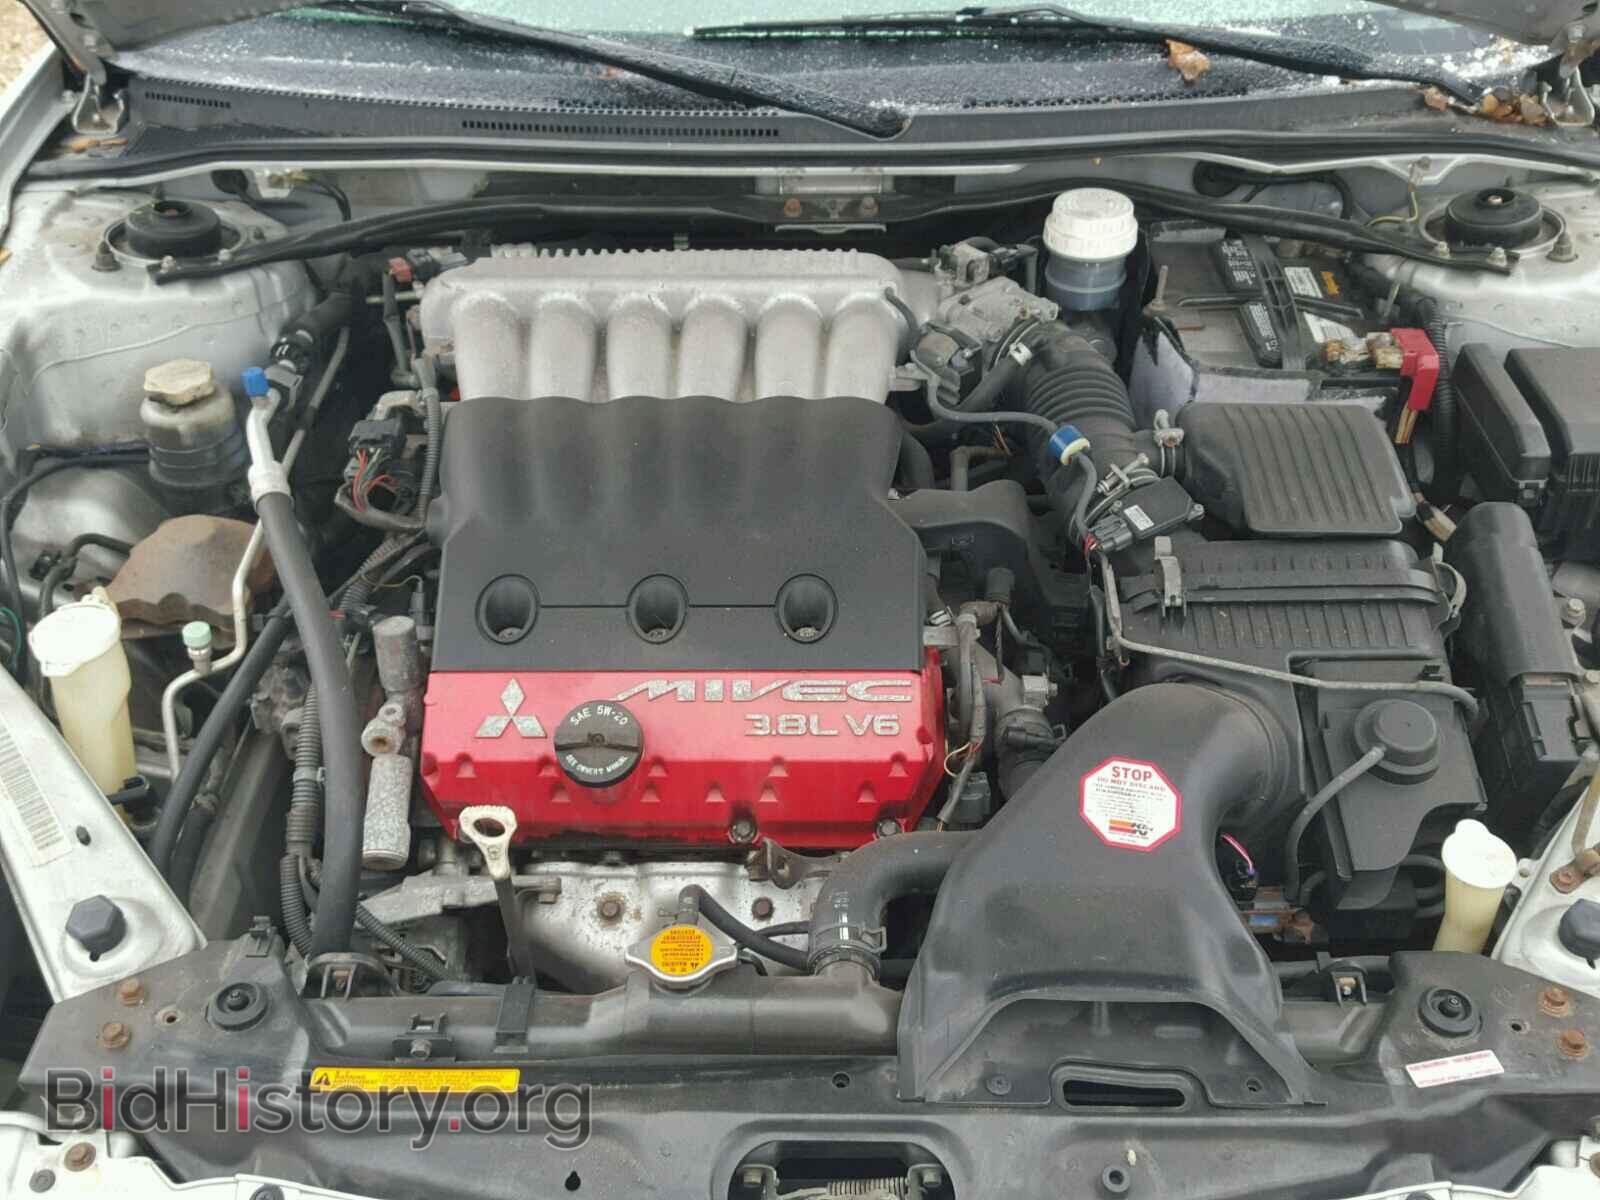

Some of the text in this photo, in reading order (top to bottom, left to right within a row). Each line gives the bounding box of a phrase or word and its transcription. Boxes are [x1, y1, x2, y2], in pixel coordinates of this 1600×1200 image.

[608, 679, 912, 702] MIVEC
[570, 705, 628, 725] SAE 5W-20
[744, 714, 901, 736] 3.8L V6
[1111, 766, 1153, 782] STOP
